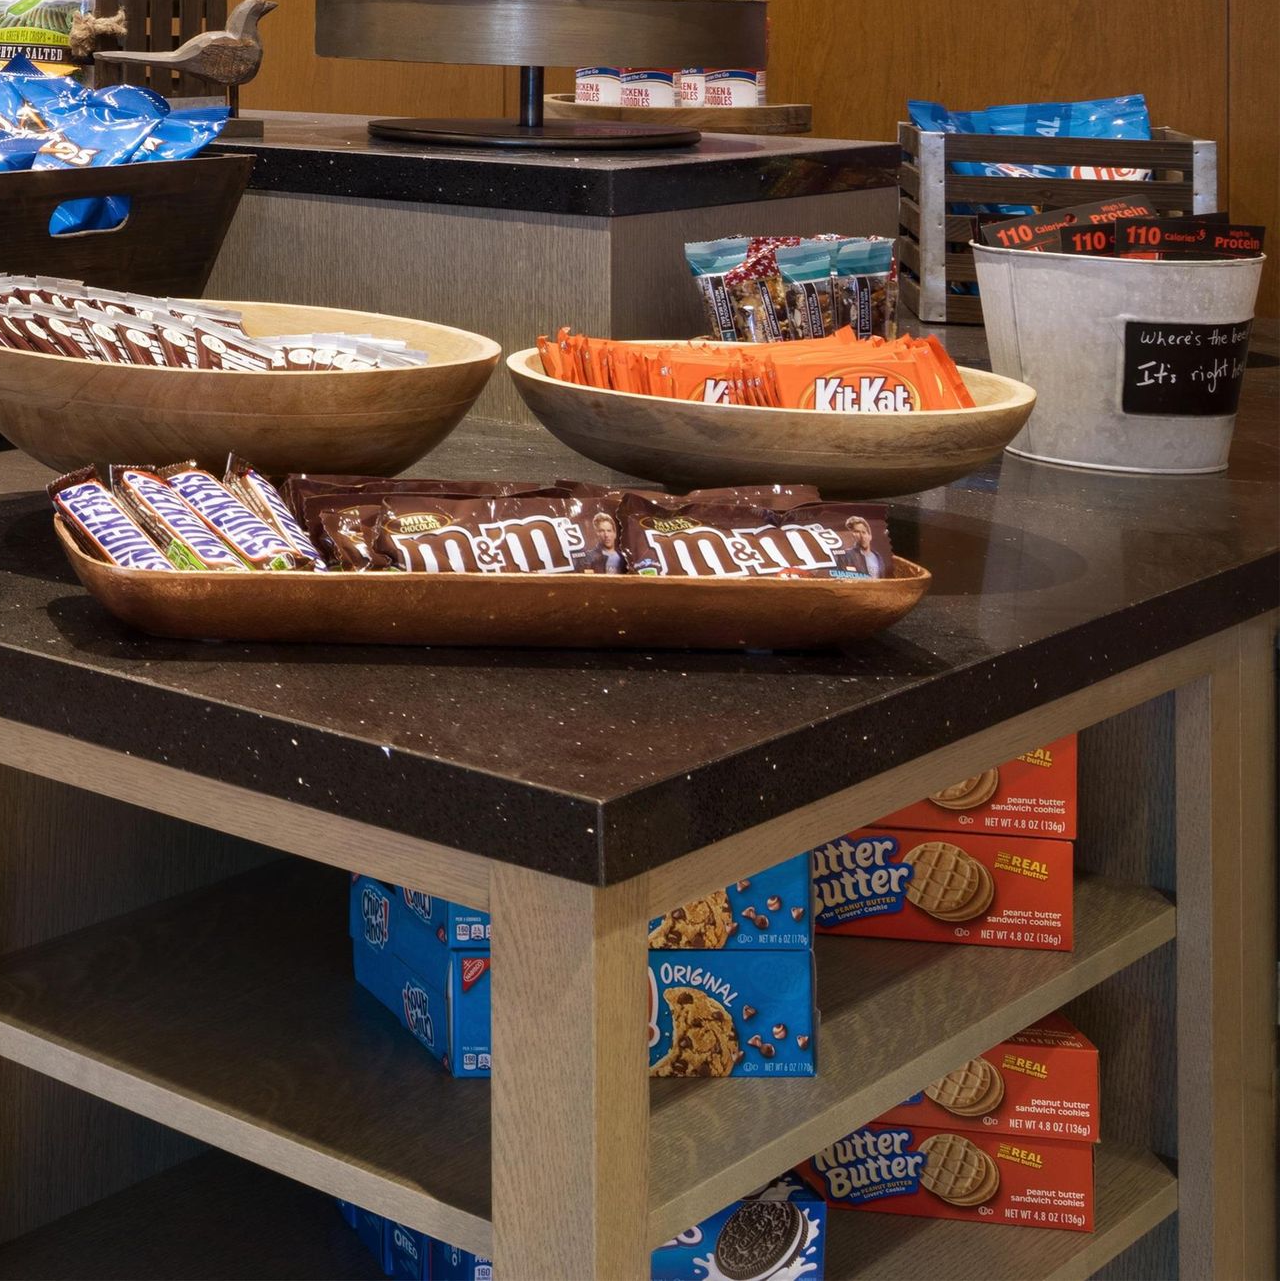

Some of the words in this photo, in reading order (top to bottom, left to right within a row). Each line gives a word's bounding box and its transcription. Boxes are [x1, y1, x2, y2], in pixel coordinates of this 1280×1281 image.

[26, 47, 63, 60] SALTED
[1090, 206, 1148, 225] Protein
[997, 224, 1033, 247] 110
[1072, 232, 1106, 251] 110
[1126, 225, 1162, 246] 110
[1214, 236, 1260, 250] Protein
[1140, 330, 1202, 347] Where's
[1207, 329, 1228, 344] the
[1136, 360, 1177, 386] It's
[1191, 359, 1228, 393] right
[400, 515, 437, 526] MILK
[991, 803, 1031, 812] sandwich
[1039, 798, 1065, 806] butter
[985, 817, 998, 826] NET
[1001, 819, 1011, 827] WT
[1014, 819, 1026, 829] 4.8
[1028, 821, 1038, 829] OZ
[1041, 821, 1065, 833] (136g)
[1012, 856, 1049, 874] REAL
[986, 915, 1027, 926] sandwich
[1029, 918, 1061, 928] cookies
[1003, 909, 1030, 919] peanut
[1033, 911, 1061, 920] butter
[981, 929, 995, 941] NET
[995, 930, 1008, 942] WT
[1009, 930, 1023, 942] 4.8
[1024, 932, 1034, 943] OZ
[1036, 933, 1061, 946] (136g)
[660, 962, 738, 1008] ORIGINAL
[1015, 1057, 1048, 1075] REAL
[1015, 1104, 1057, 1115] sandwich
[1058, 1107, 1090, 1118] cookies
[1031, 1099, 1060, 1109] peanut
[1063, 1100, 1090, 1109] butter
[1009, 1118, 1024, 1130] NET
[1025, 1120, 1037, 1130] WT
[1038, 1121, 1053, 1132] 4.8
[1054, 1122, 1064, 1133] OZ
[1066, 1124, 1090, 1136] (136g)
[1011, 1147, 1043, 1165] REAL
[827, 1154, 923, 1198] Butter
[1010, 1194, 1052, 1205] sandwich
[1053, 1197, 1085, 1207] cookies
[1026, 1188, 1055, 1198] peanut
[1058, 1190, 1085, 1199] butter
[1004, 1208, 1019, 1220] NET
[1020, 1209, 1033, 1220] WT
[1034, 1211, 1047, 1222] 4.8
[1048, 1212, 1058, 1223] OZ
[1060, 1213, 1086, 1226] (136g)
